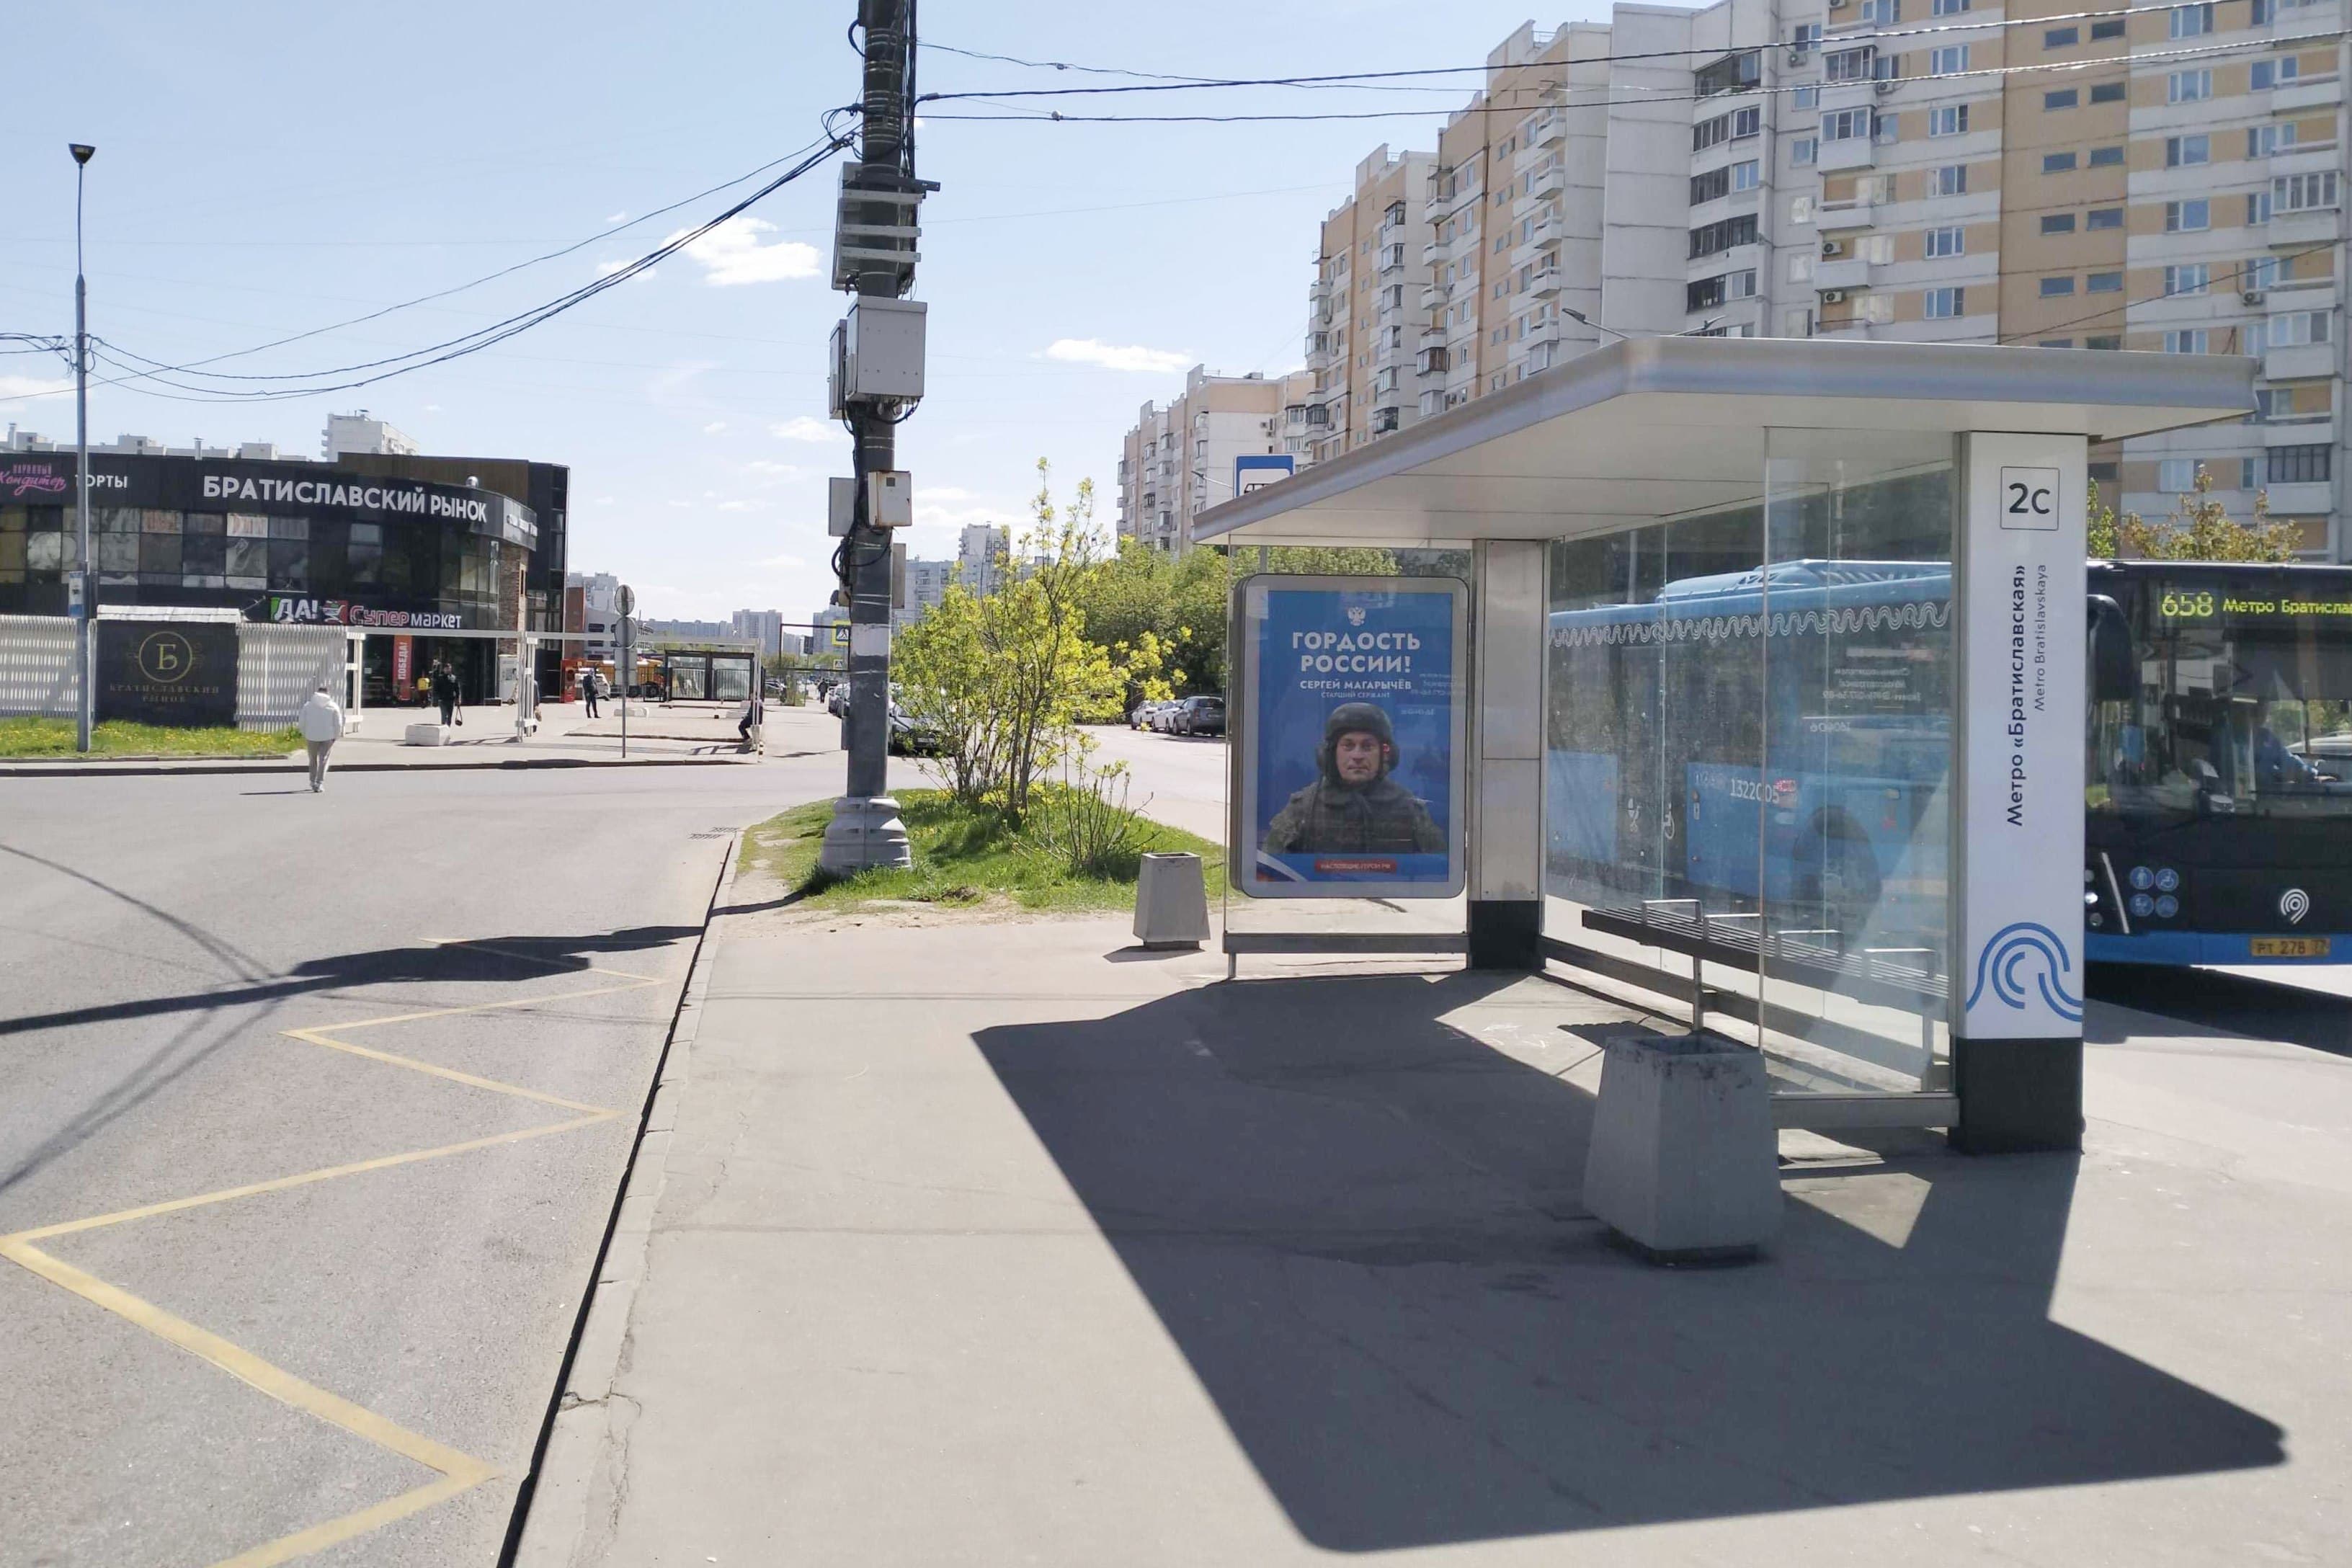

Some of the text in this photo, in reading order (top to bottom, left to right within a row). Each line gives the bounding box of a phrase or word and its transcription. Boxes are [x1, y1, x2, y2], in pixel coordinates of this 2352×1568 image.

[203, 475, 488, 523] БРАТИСЛАВСКИЙ РЫНОК
[274, 598, 318, 621] ДА!
[2162, 592, 2214, 617] 658
[2223, 598, 2275, 614] Метро
[1292, 631, 1421, 652] ГОРДОСТЬ
[2034, 564, 2049, 712] Metro Bratislavskaya
[397, 641, 409, 680] ПОБЕДА!
[1300, 655, 1411, 673] РОССИИ!
[1299, 679, 1340, 690] СЕРГЕЙ
[1344, 678, 1412, 690] МАГАРЫЧЁВ
[2006, 565, 2027, 827] Метро «Братиславская»
